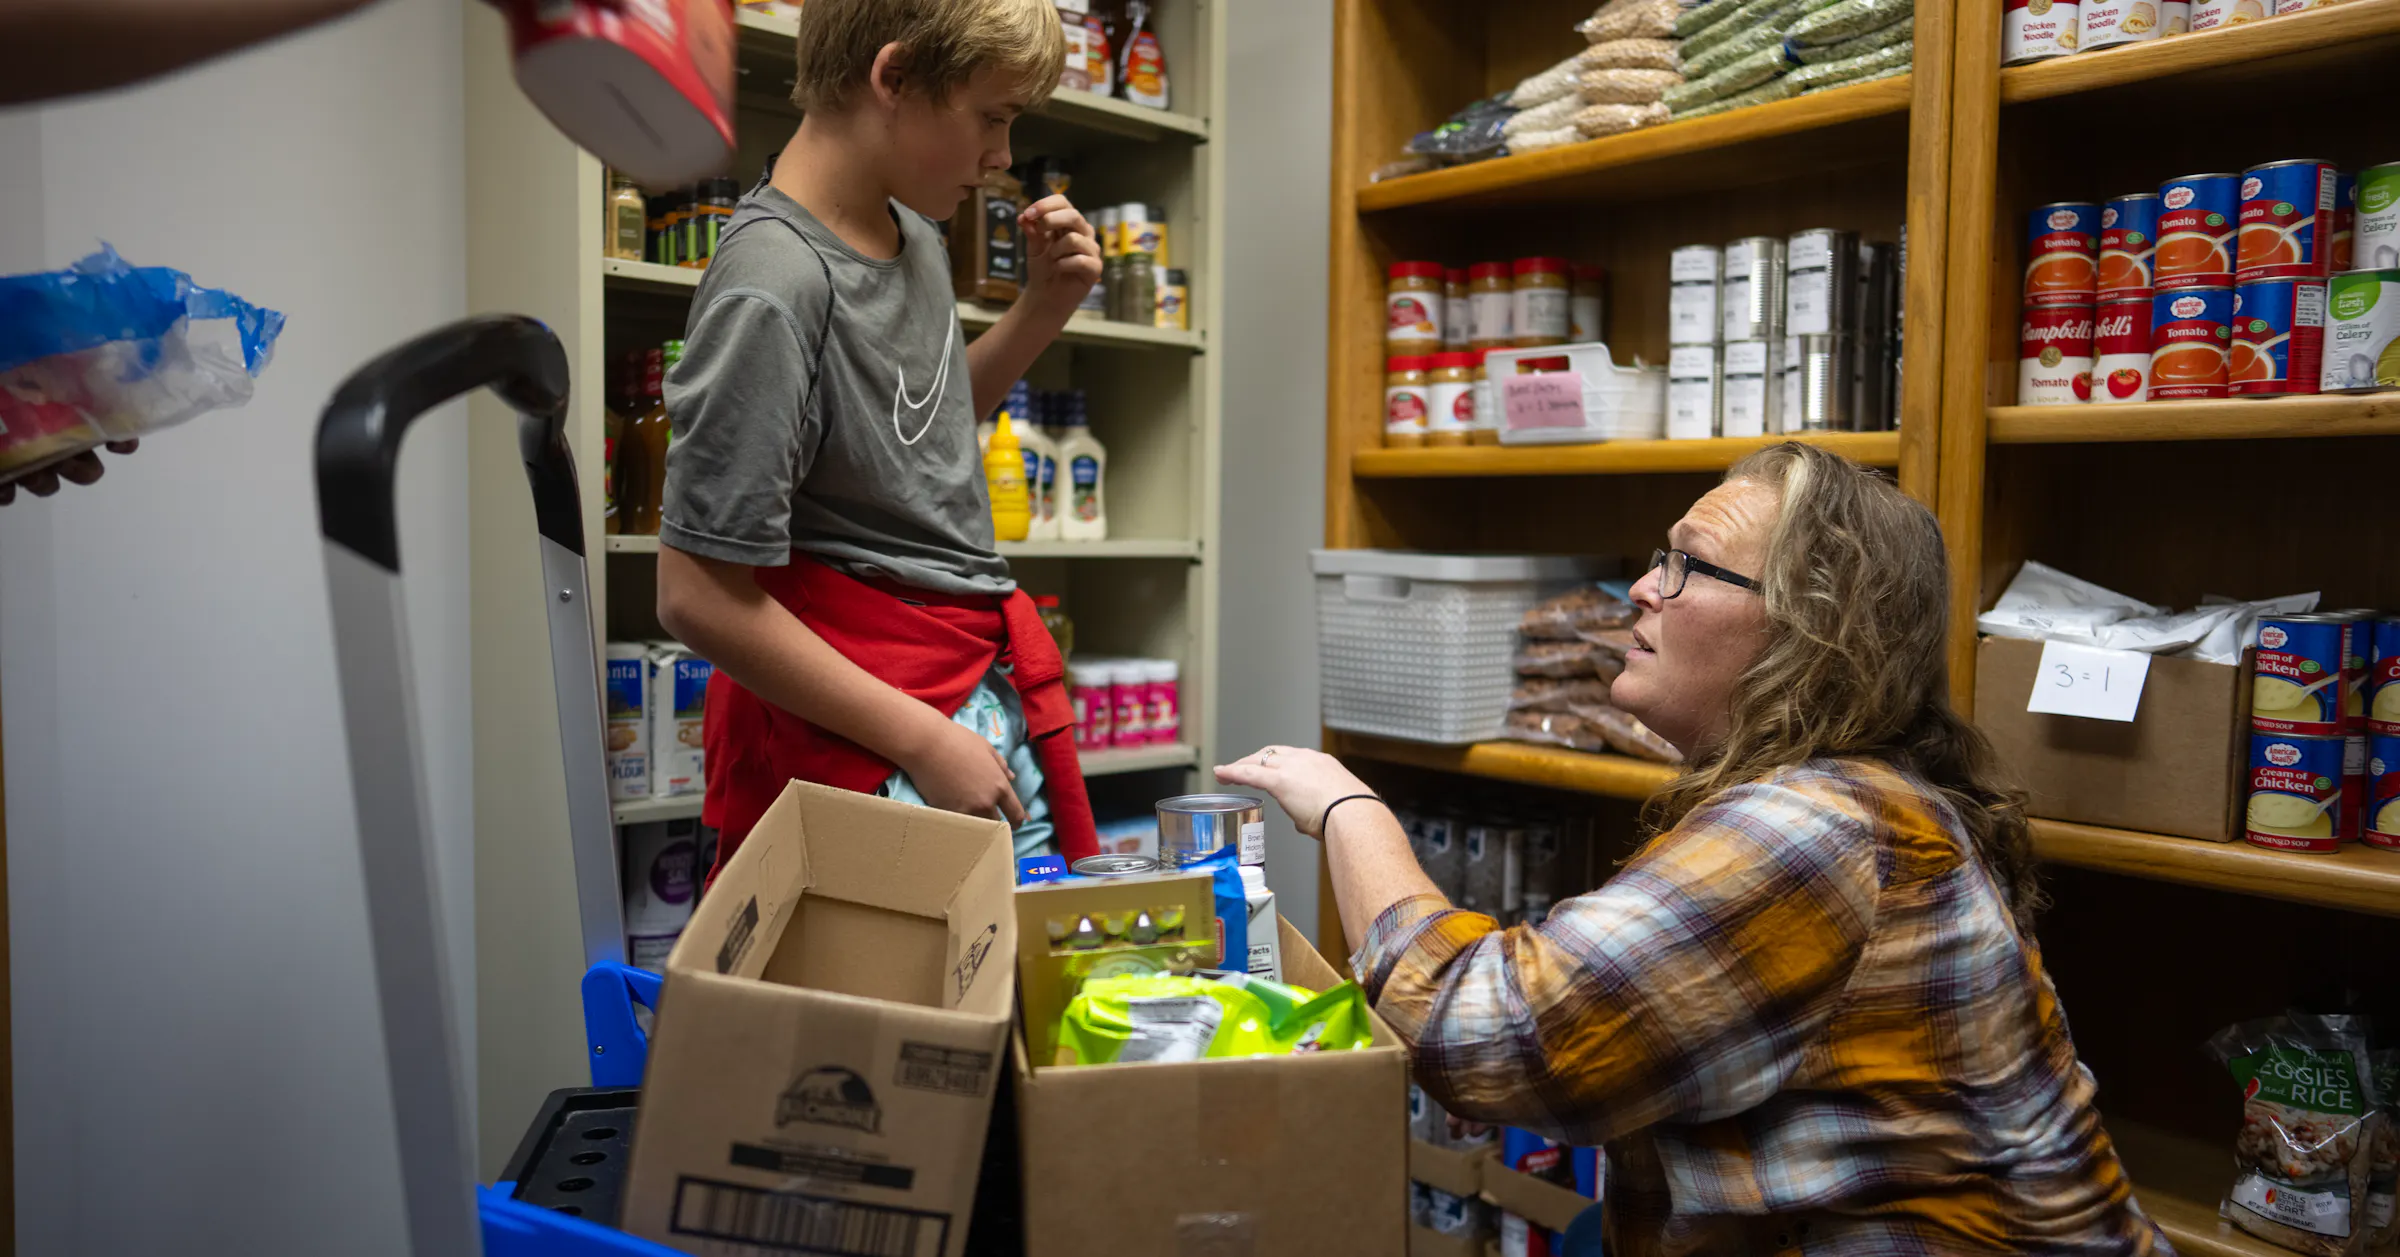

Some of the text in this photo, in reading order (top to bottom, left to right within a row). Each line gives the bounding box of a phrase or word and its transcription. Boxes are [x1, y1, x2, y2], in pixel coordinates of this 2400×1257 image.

[2087, 8, 2119, 21] Chicken
[2022, 22, 2056, 32] Chicken
[2087, 18, 2117, 31] Noodle
[2023, 31, 2054, 41] Noodle
[2161, 217, 2196, 230] Tomato
[2363, 222, 2397, 233] Celery
[2044, 238, 2081, 249] Tomato
[2167, 327, 2208, 338] Tomato
[2336, 330, 2372, 340] Celery
[2031, 378, 2069, 388] Tomato
[2282, 655, 2294, 664] of
[2055, 664, 2110, 692] 3 = 1
[2275, 722, 2294, 730] SOUP
[2270, 747, 2297, 756] American
[612, 765, 645, 779] FLOUR
[2259, 768, 2308, 781] Cream of
[2254, 777, 2315, 793] Chicken
[2253, 834, 2310, 847] CONDENSED SOUP
[1247, 947, 1270, 955] Facts
[2264, 1083, 2353, 1109] and RICE
